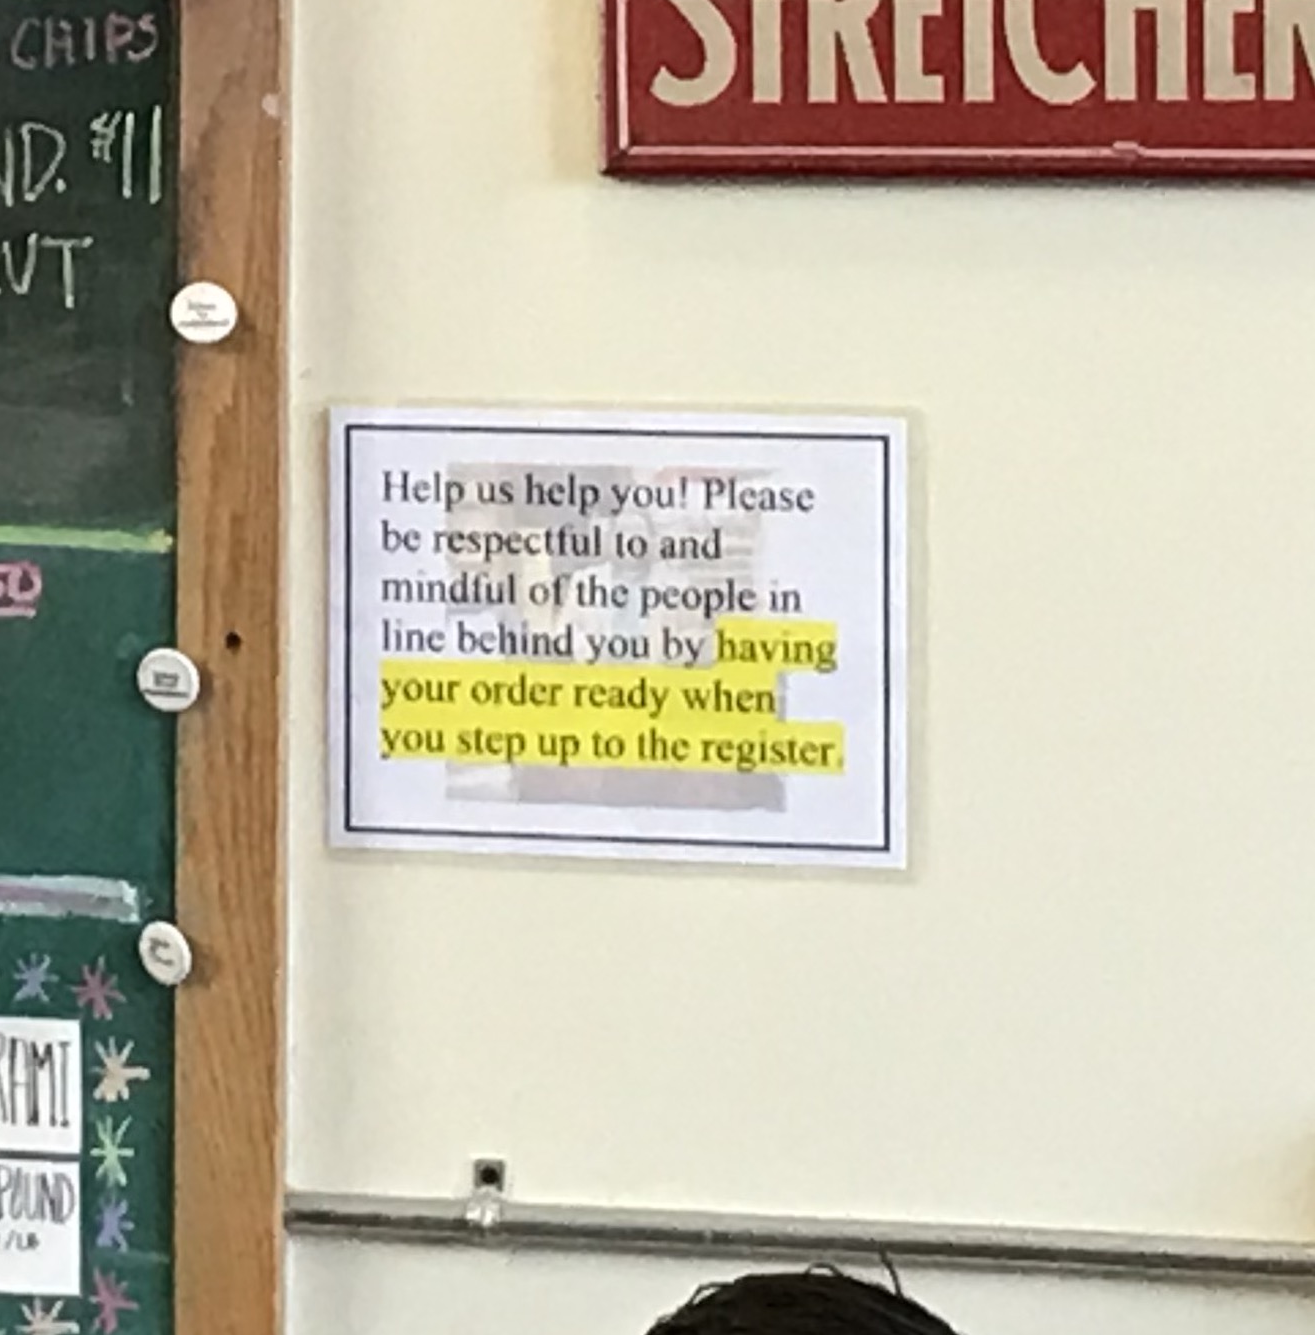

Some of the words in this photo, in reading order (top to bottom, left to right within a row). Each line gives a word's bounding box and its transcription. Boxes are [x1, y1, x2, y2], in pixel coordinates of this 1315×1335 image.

[10, 12, 158, 70] CHIPS
[89, 105, 164, 205] $11
[381, 470, 465, 513] Help
[476, 480, 514, 505] us
[525, 472, 600, 514] help
[610, 475, 688, 516] you!
[701, 477, 816, 513] Please
[381, 520, 421, 553] be
[432, 523, 603, 565] respectful
[615, 532, 648, 560] to
[659, 527, 723, 561] and
[381, 572, 517, 605] mindful
[529, 574, 568, 606] of
[575, 577, 629, 608] the
[640, 580, 757, 621] people
[768, 579, 803, 612] in
[381, 619, 446, 653] line
[457, 621, 573, 657] behind
[586, 632, 650, 666] you
[662, 627, 709, 666] by
[715, 629, 837, 673] having
[381, 679, 458, 713] your
[470, 674, 561, 708] order
[572, 679, 670, 720] ready
[681, 679, 776, 714] when
[381, 727, 444, 760] you
[457, 728, 525, 765] step
[537, 734, 581, 767] up
[592, 730, 626, 760] to
[636, 730, 689, 761] the
